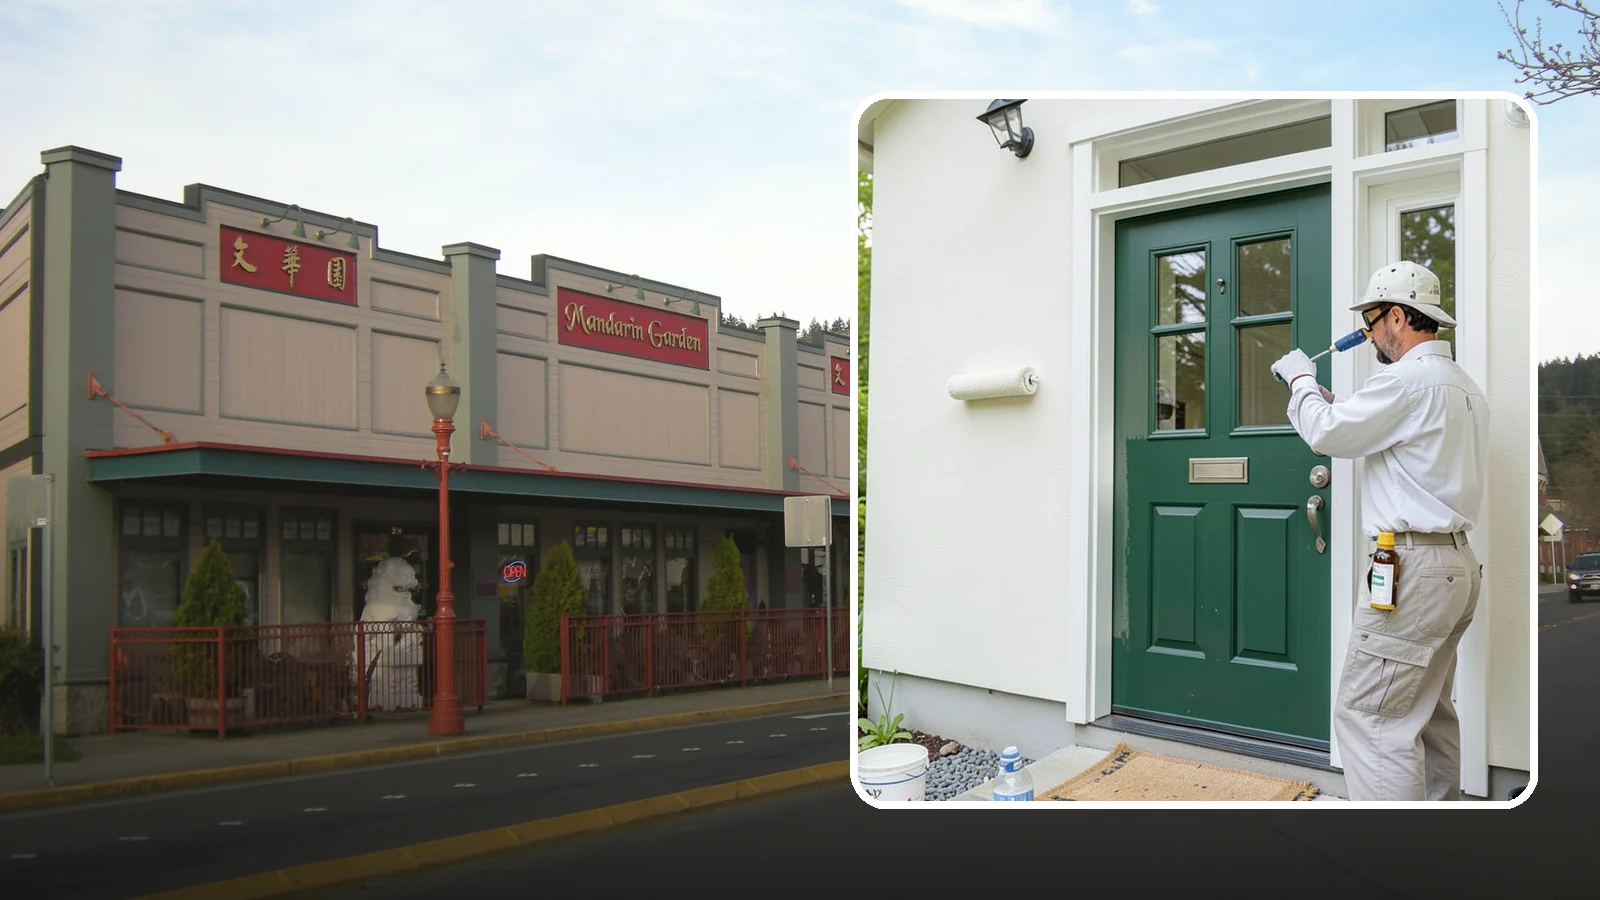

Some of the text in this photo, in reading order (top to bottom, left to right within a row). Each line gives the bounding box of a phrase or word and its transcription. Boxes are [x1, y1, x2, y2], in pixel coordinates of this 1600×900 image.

[231, 235, 347, 291] 文華園
[564, 302, 702, 352] Mandarin Garden
[503, 565, 527, 578] OPEN
